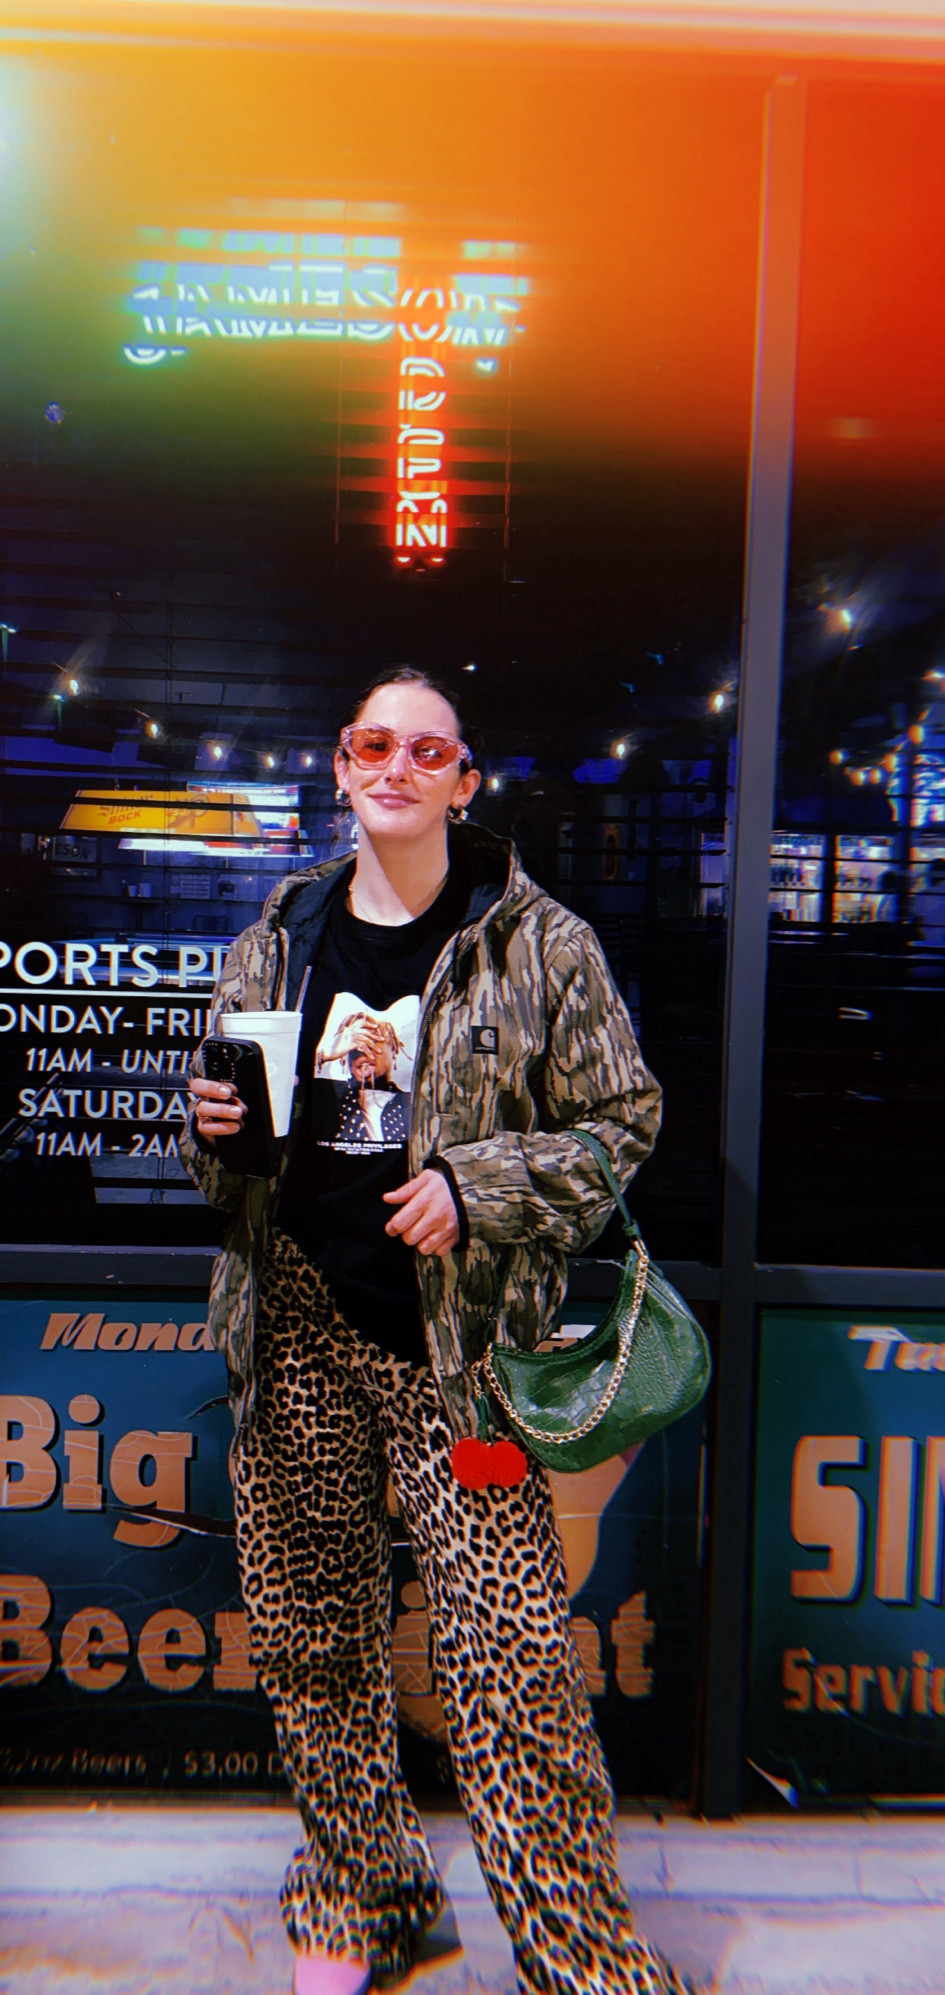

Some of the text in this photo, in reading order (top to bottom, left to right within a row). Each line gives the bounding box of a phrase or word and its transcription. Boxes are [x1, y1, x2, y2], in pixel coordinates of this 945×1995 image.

[109, 810, 142, 825] BOCK
[146, 1007, 211, 1037] FRI
[26, 1047, 93, 1073] 11AM
[121, 1049, 197, 1075] UNTI
[36, 1131, 103, 1157] 11AM
[0, 1394, 193, 1548] Big
